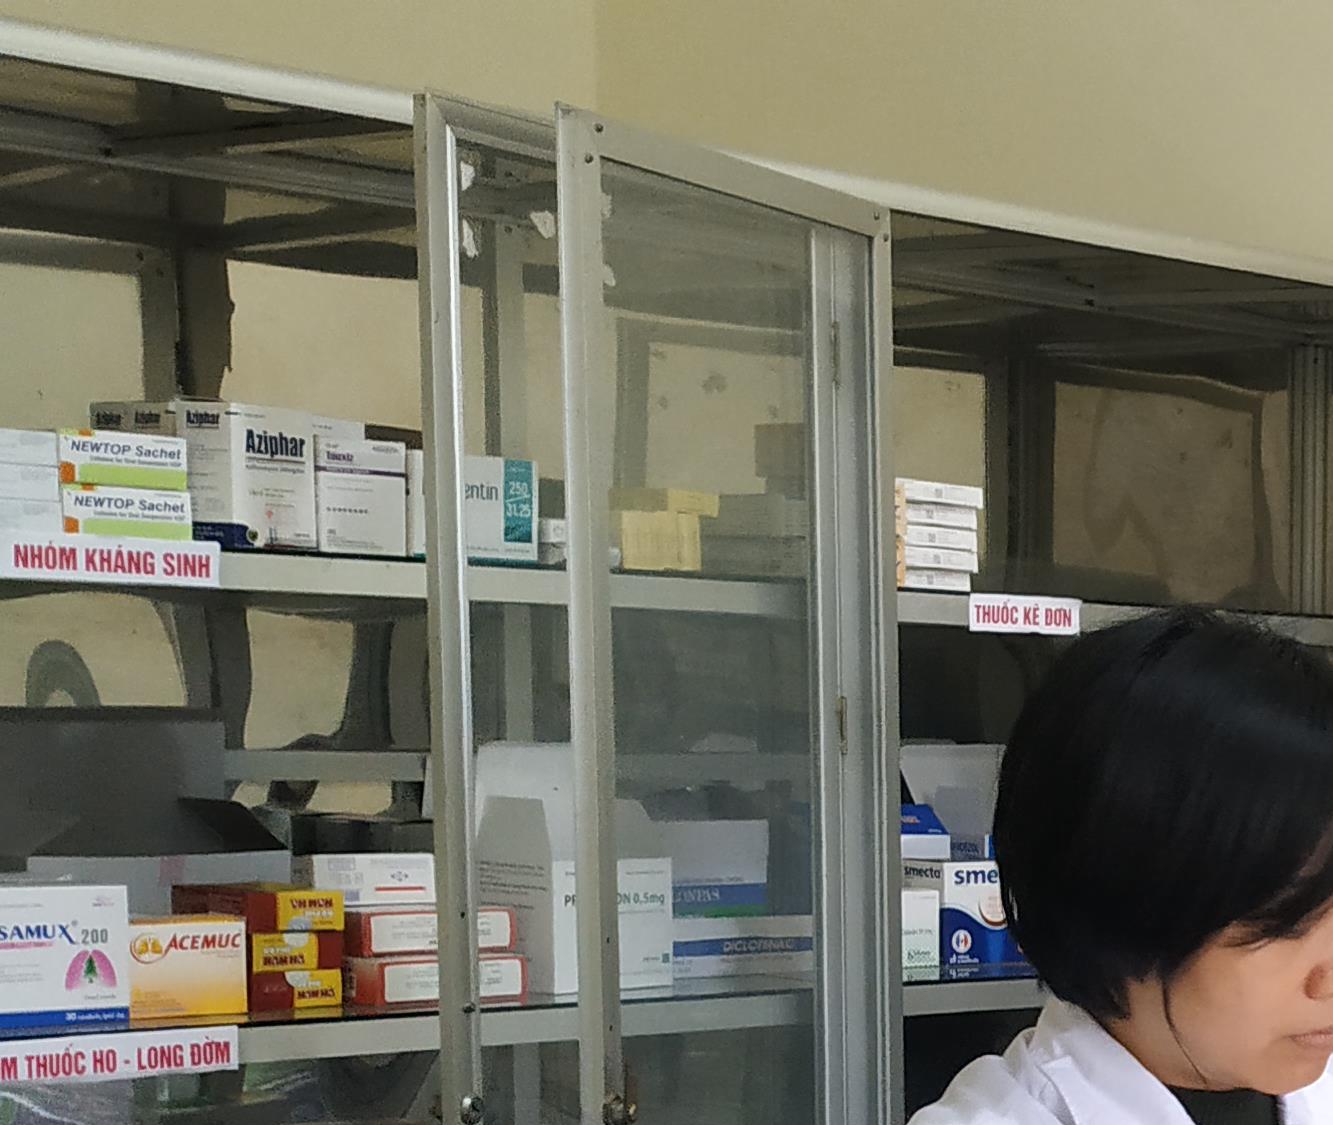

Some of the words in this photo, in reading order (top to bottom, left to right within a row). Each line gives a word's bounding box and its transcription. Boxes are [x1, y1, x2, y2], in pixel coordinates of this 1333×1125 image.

[70, 440, 131, 455] NEWTOP
[135, 446, 181, 460] Sachet
[245, 429, 306, 458] Aziphar
[465, 483, 498, 501] entin
[74, 495, 134, 510] NEWTOP
[139, 500, 185, 514] Sachet
[14, 541, 77, 571] NHÓM
[85, 545, 155, 575] KHÁNG
[163, 553, 210, 578] SINH
[975, 600, 1018, 626] THUỐC
[1044, 605, 1072, 628] ĐƠN
[904, 865, 941, 879] smecta
[954, 869, 999, 885] sme
[81, 929, 108, 944] 200
[167, 932, 241, 950] ACEMUC
[25, 1043, 86, 1077] THUỐC
[93, 1050, 117, 1073] HO
[137, 1048, 184, 1071] LONG
[190, 1036, 231, 1066] ĐỜM
